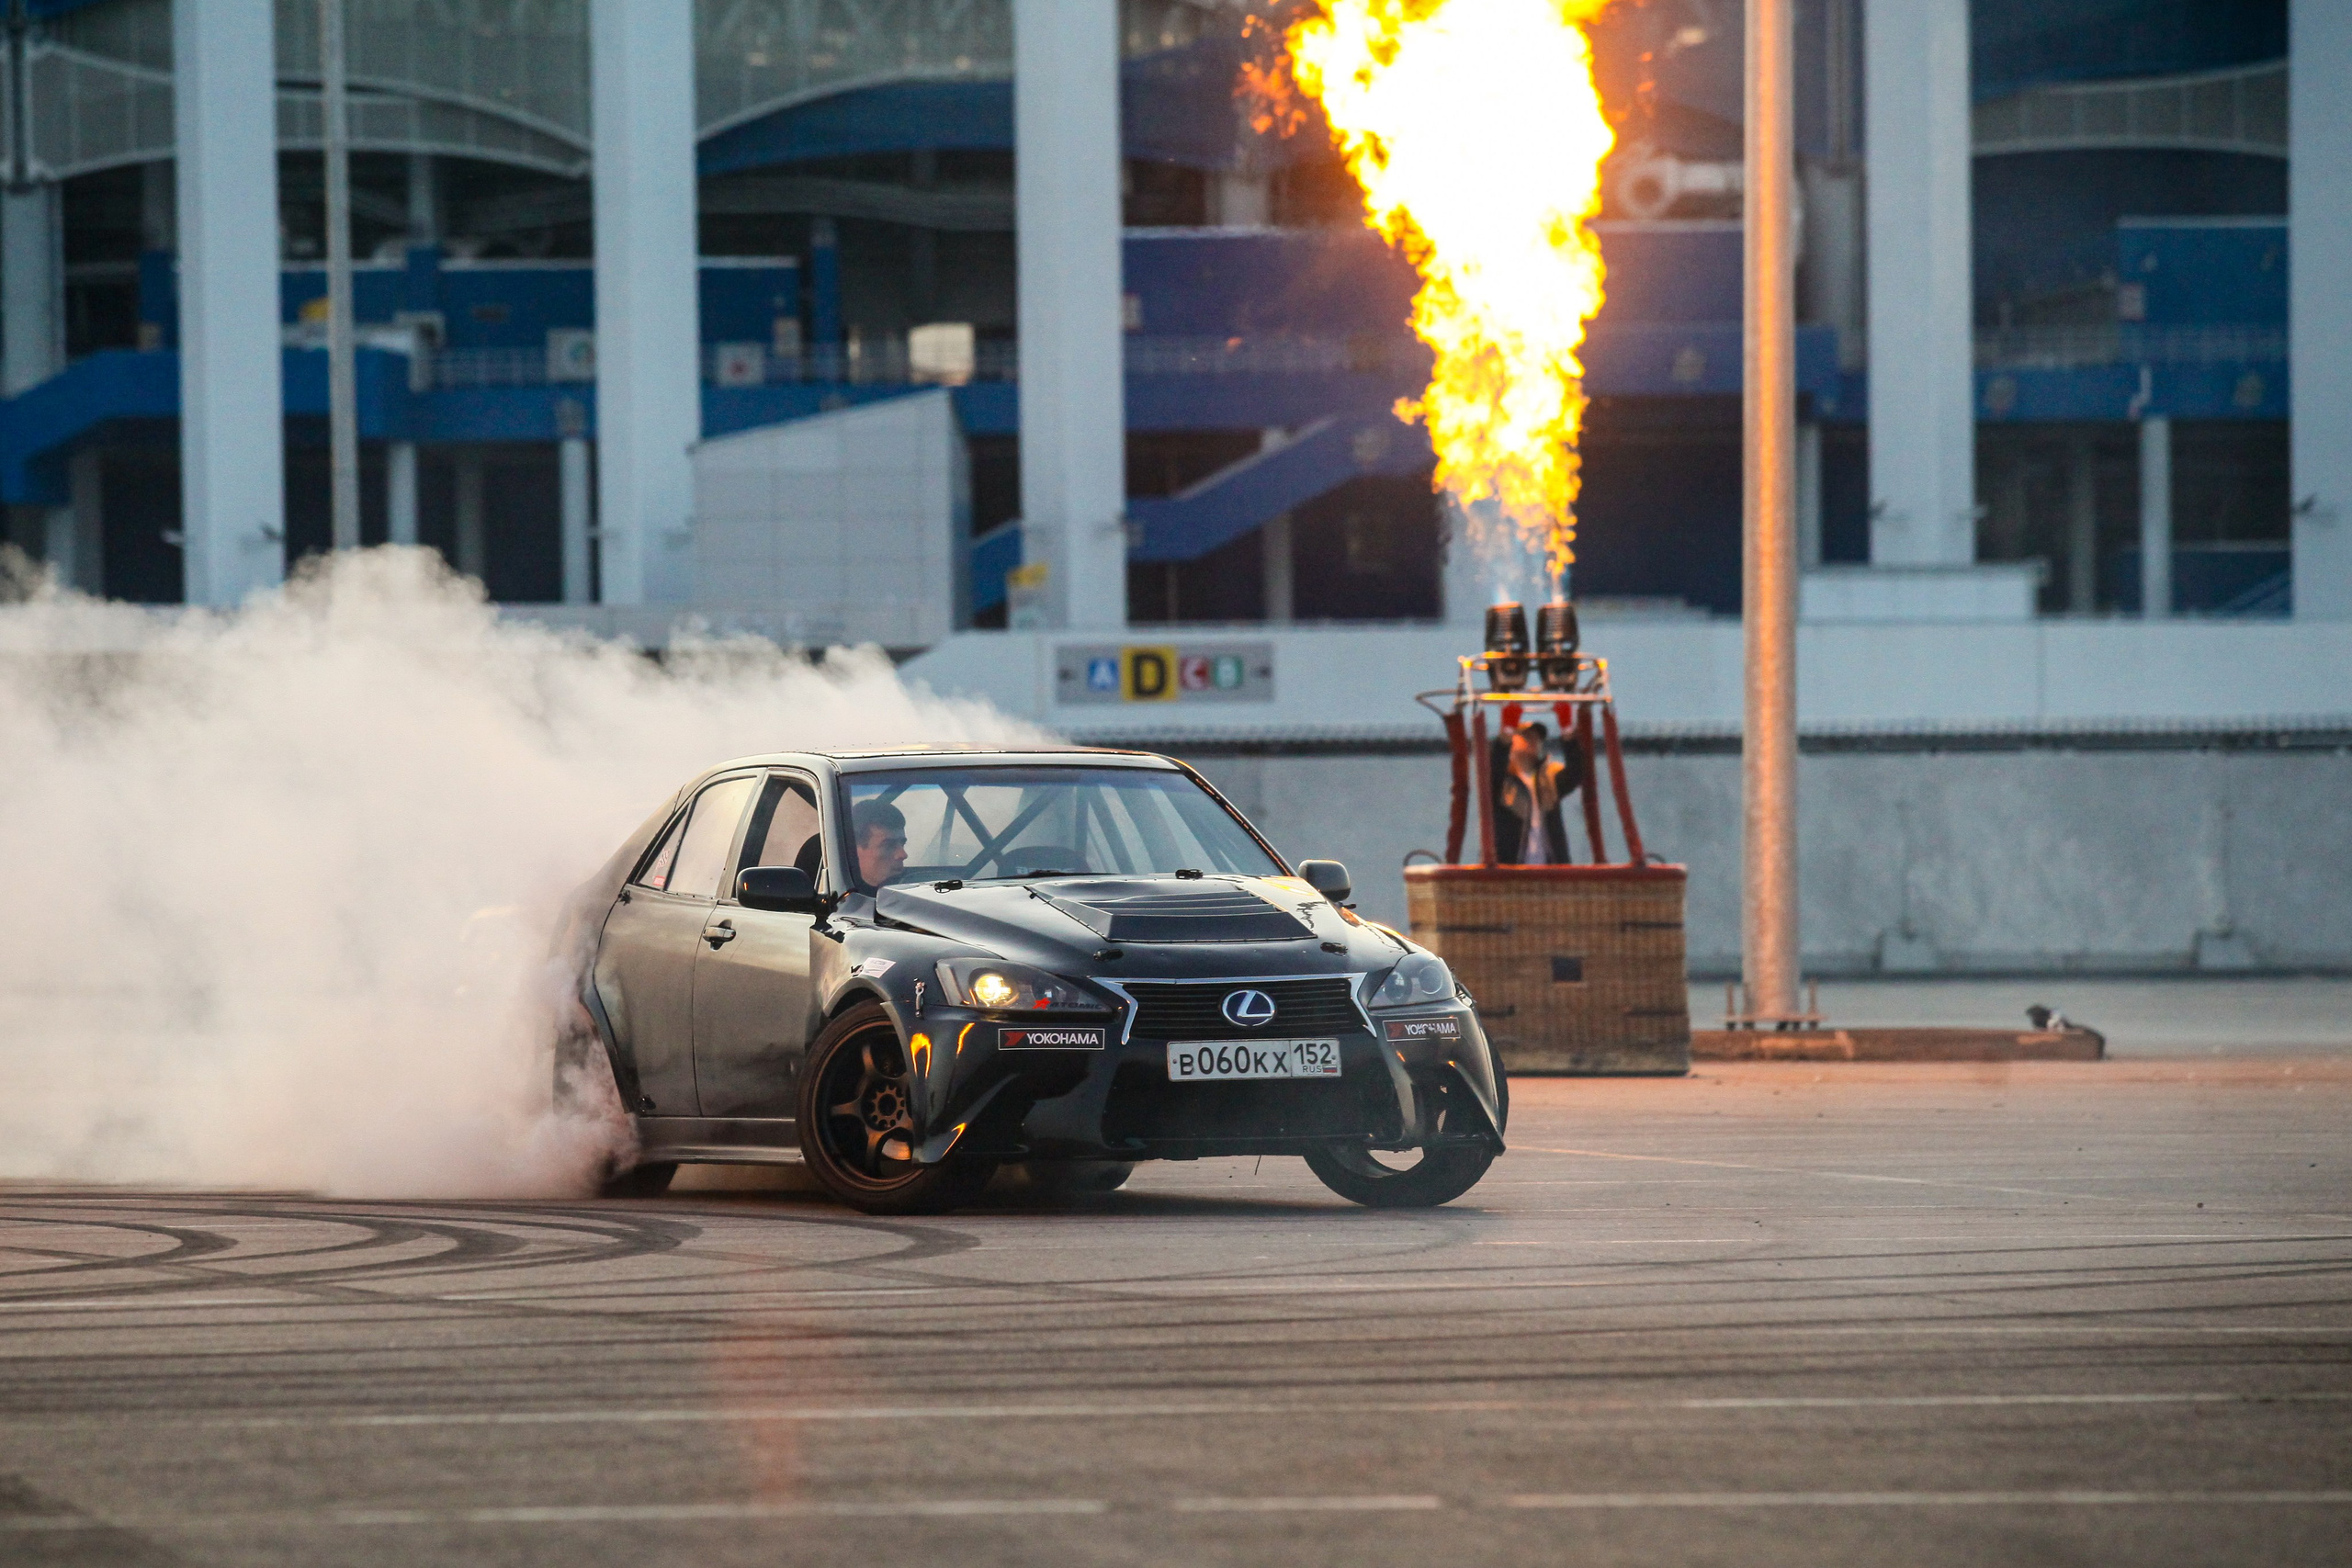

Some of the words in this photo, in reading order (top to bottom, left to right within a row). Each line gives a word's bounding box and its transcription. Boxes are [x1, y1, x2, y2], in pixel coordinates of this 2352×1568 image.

[1132, 653, 1167, 697] D
[1026, 1032, 1099, 1044] YOKOHAMA
[1294, 1043, 1332, 1066] 152
